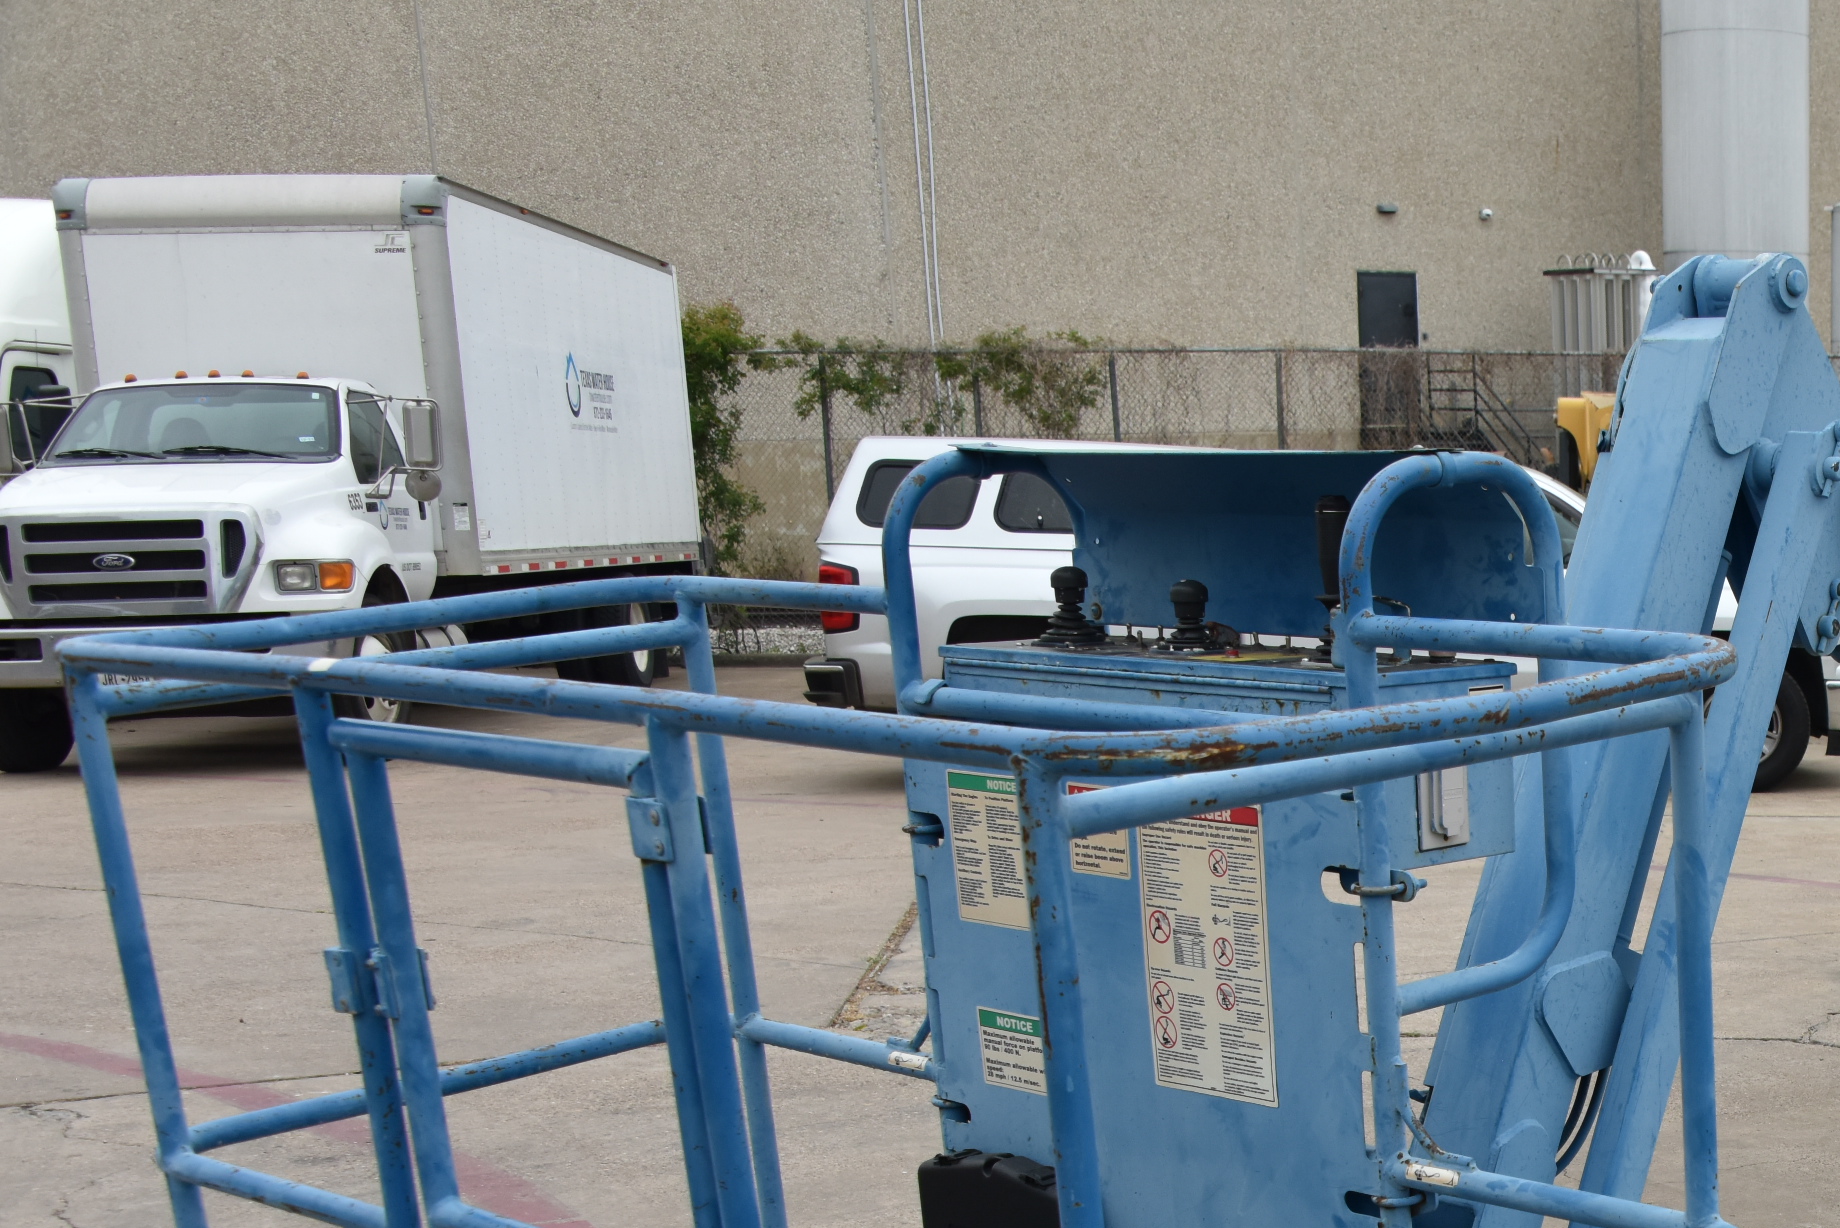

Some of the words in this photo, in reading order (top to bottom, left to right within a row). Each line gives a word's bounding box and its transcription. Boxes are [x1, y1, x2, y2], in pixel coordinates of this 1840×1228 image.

[102, 556, 124, 566] Ford
[986, 780, 1016, 792] NOTICE
[996, 1016, 1033, 1032] NOTICE
[983, 1030, 1008, 1040] Maximum
[1009, 1036, 1034, 1045] allowable
[1004, 1041, 1017, 1049] force
[986, 1057, 1011, 1068] Maximum
[1012, 1064, 1037, 1073] allowable
